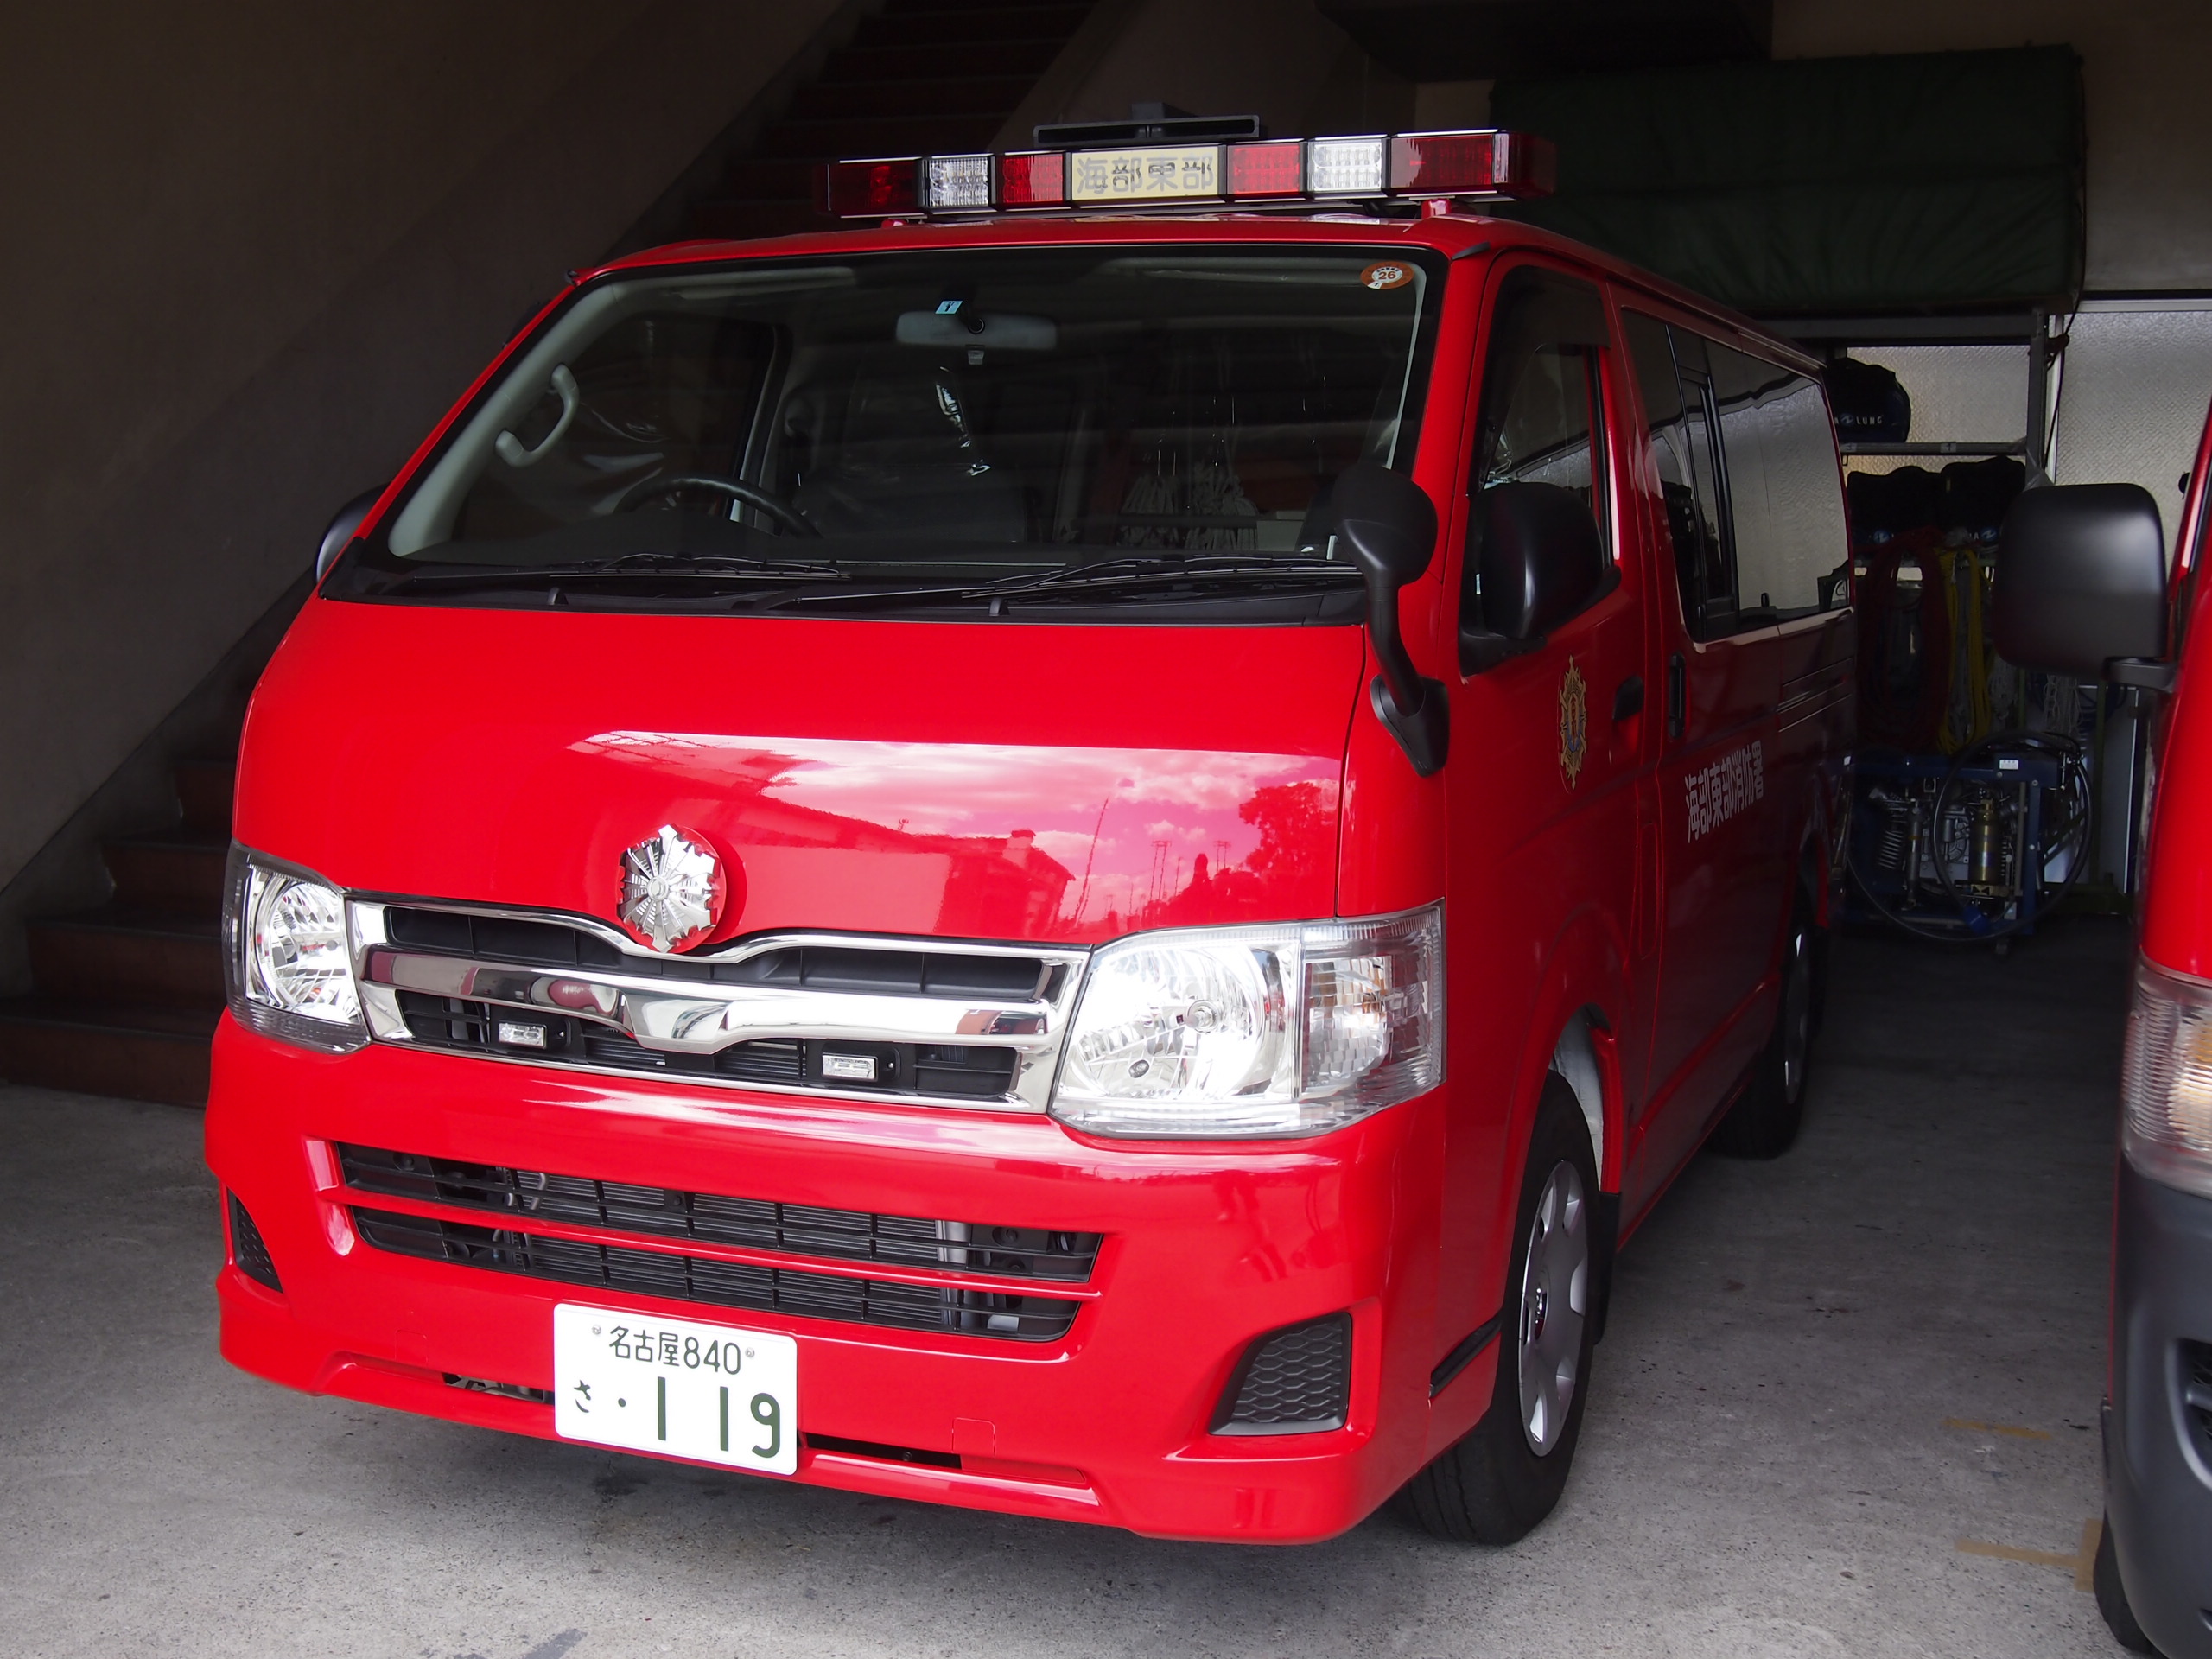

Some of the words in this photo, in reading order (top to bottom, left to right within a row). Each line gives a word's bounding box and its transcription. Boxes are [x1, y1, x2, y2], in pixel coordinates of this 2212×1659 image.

[1077, 151, 1215, 194] 海部東部
[1378, 270, 1396, 280] 26
[1856, 416, 1883, 425] LUNG
[1684, 740, 1764, 844] 海部東部消防署
[609, 1325, 741, 1376] 名古屋840
